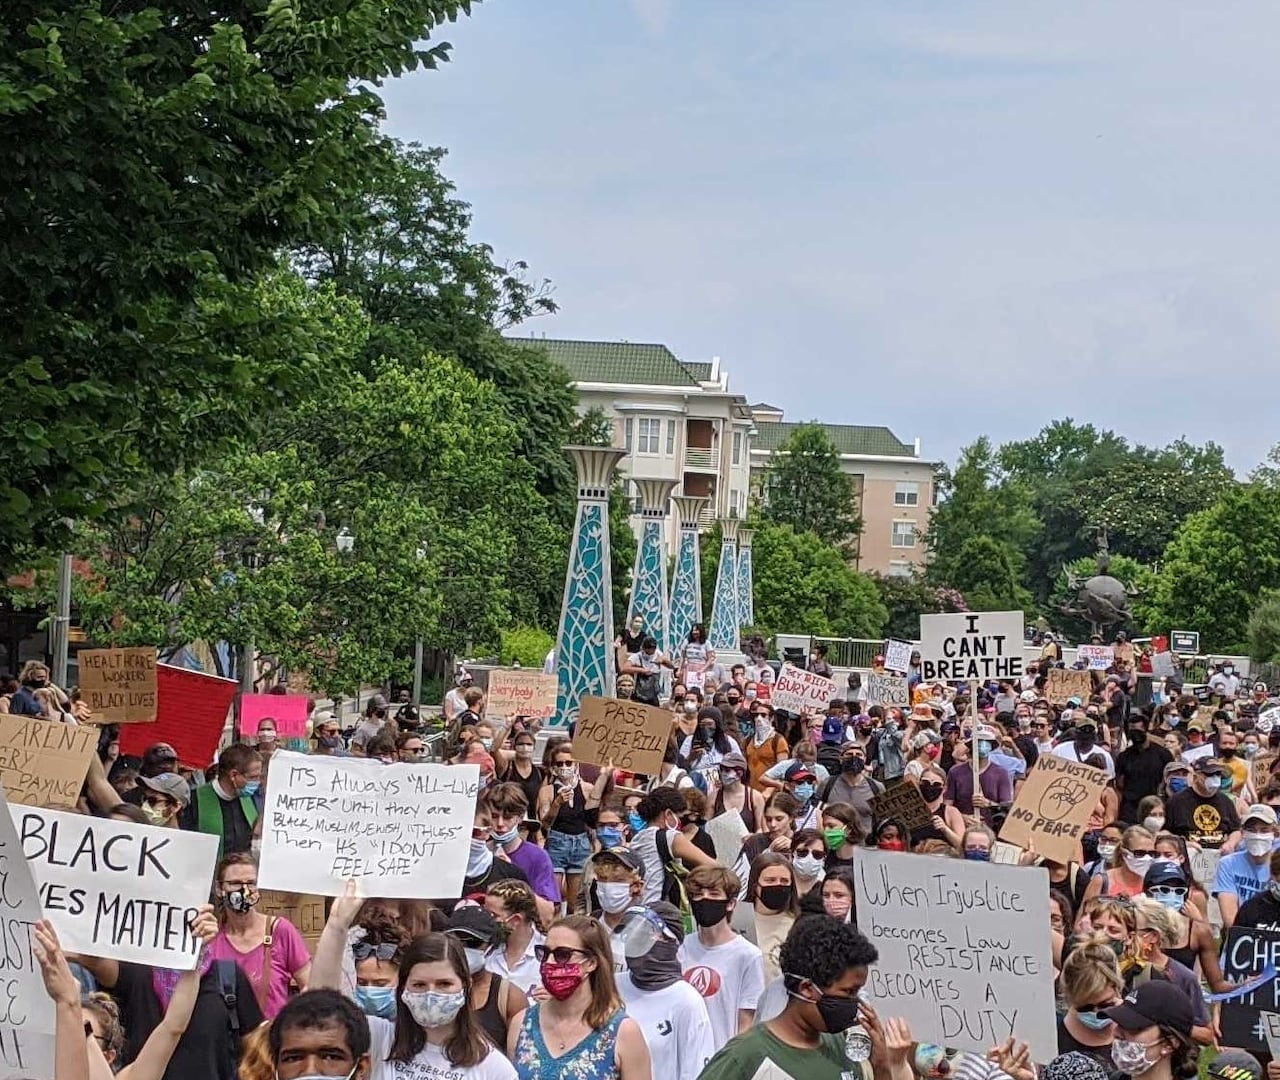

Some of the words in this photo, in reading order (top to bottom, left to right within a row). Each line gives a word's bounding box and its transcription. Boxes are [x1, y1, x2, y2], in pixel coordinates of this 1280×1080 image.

[965, 615, 979, 634] I
[943, 635, 1006, 658] CAN'T
[84, 654, 153, 669] HEALTHCARE
[923, 657, 1022, 680] BREATHE
[92, 691, 125, 709] BLACK
[129, 692, 155, 707] LIVES
[777, 676, 810, 699] BURY
[604, 701, 647, 727] PASS
[9, 721, 94, 753] AREN'T
[578, 719, 632, 746] HOUSE
[631, 730, 662, 753] BILL
[19, 772, 78, 798] PAYING
[1038, 757, 1058, 772] NO
[1057, 762, 1108, 786] JUSTICE
[384, 802, 421, 821] they
[426, 806, 452, 815] are
[1011, 808, 1033, 823] NO
[1032, 817, 1081, 838] PEACE
[21, 814, 171, 880] BLACK
[330, 856, 374, 877] FEEL
[860, 860, 929, 906] When
[932, 874, 1025, 914] Injustice
[92, 892, 200, 955] MATTER
[871, 917, 948, 943] becomes
[966, 926, 1010, 950] Law
[907, 944, 1039, 976] RESISTANCE
[871, 969, 960, 1000] BECOMES
[985, 983, 998, 1005] A
[940, 1004, 1018, 1046] DUTY
